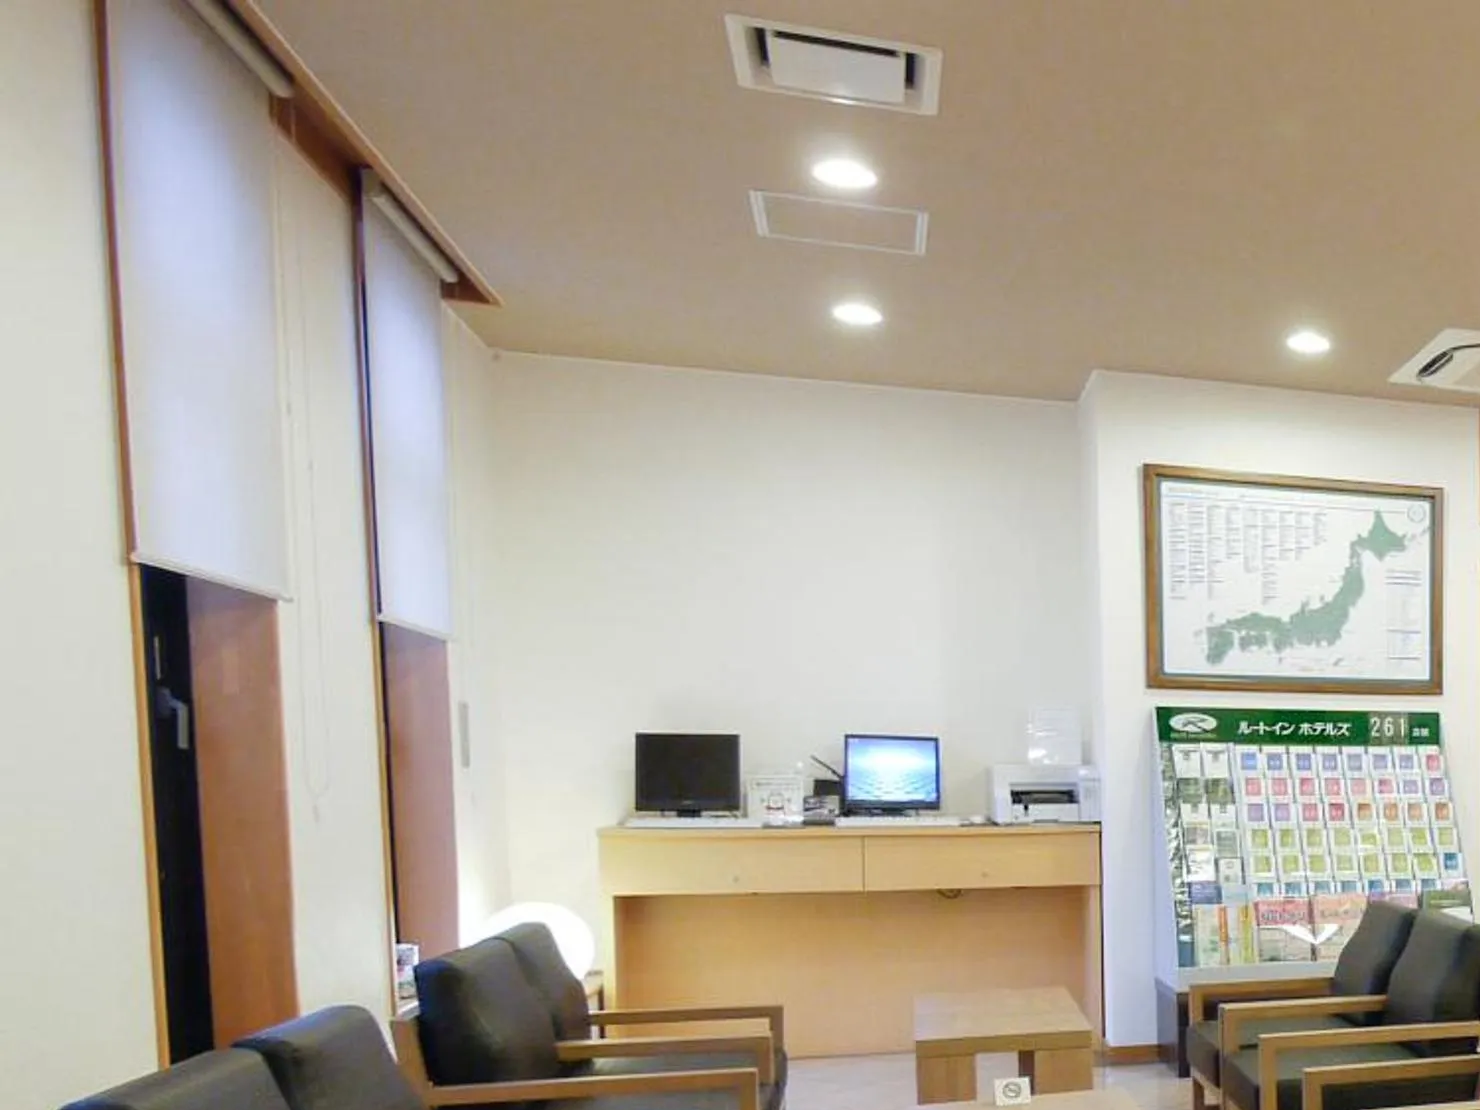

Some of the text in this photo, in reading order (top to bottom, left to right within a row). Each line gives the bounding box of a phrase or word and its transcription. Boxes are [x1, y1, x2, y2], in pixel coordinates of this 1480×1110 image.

[1237, 720, 1295, 735] ルートイン
[1299, 722, 1352, 736] ホテルズ
[1371, 717, 1405, 737] 261
